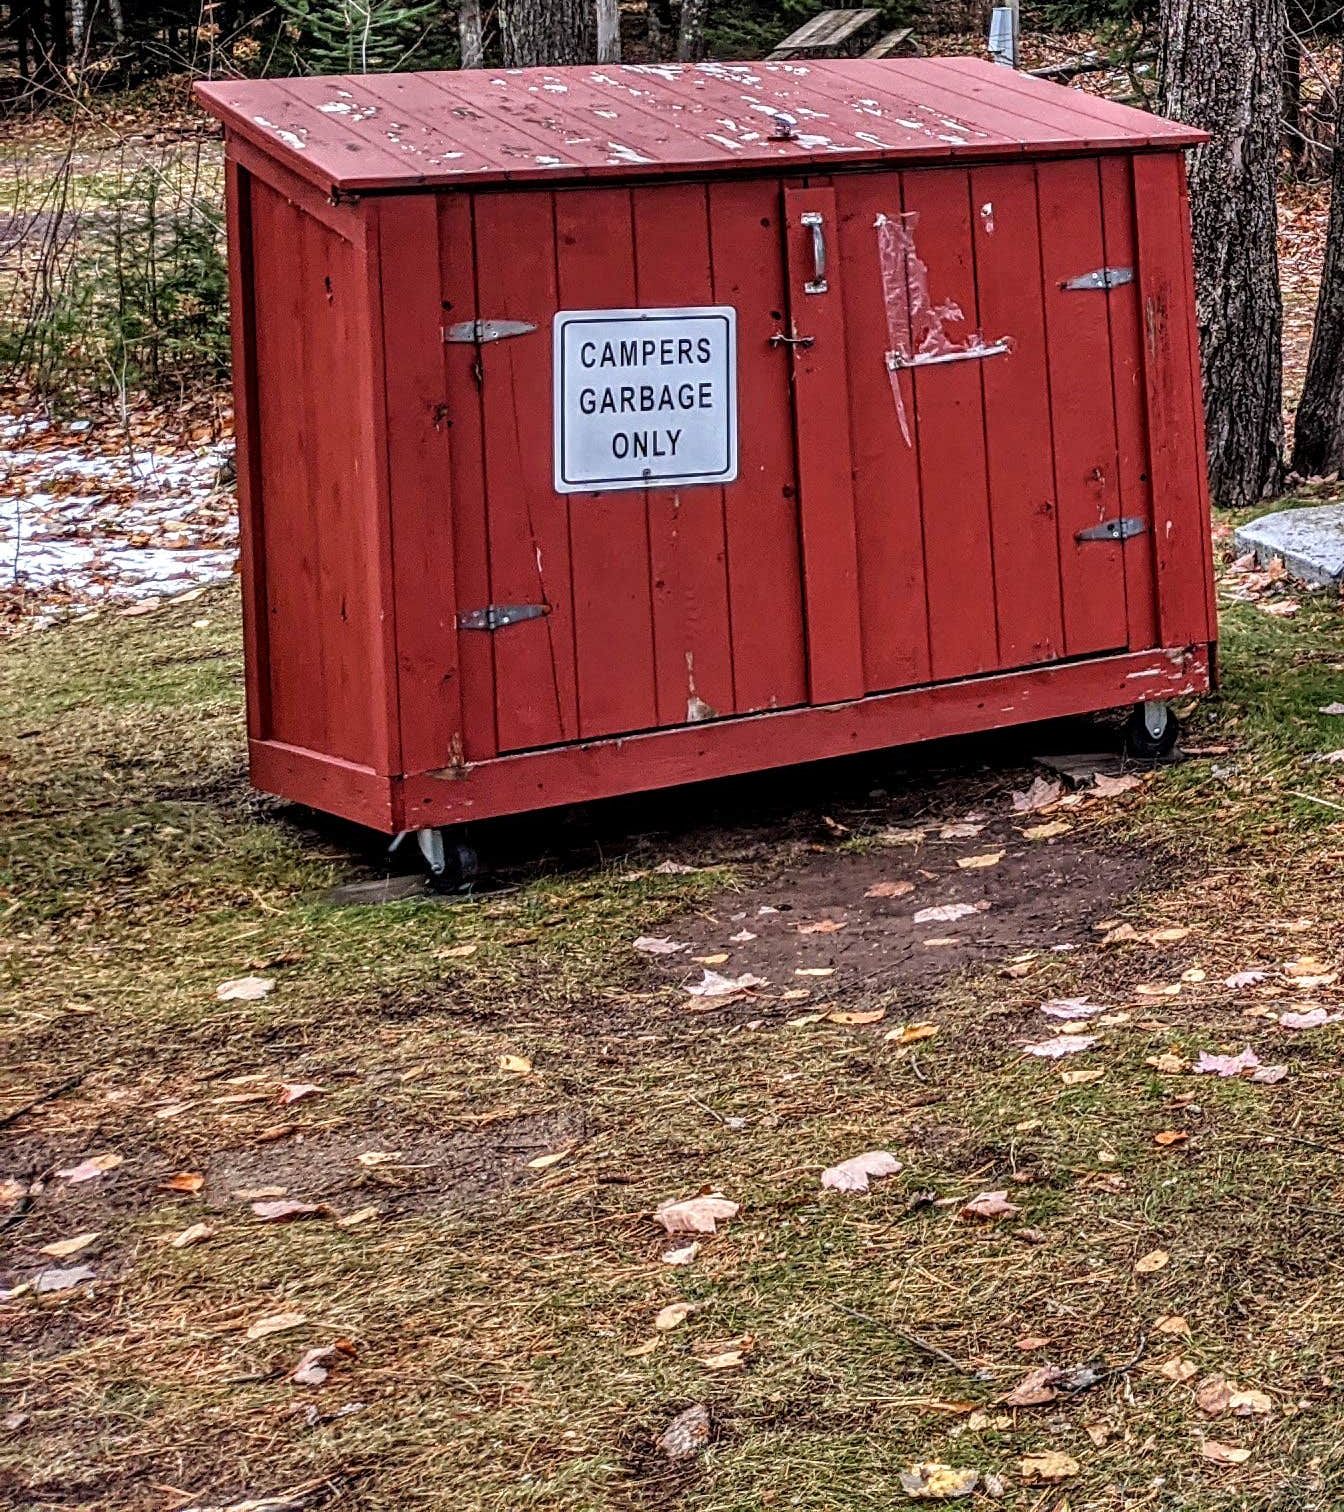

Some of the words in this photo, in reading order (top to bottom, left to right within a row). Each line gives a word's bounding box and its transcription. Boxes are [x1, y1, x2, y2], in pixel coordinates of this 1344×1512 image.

[580, 337, 712, 368] CAMPERS
[579, 382, 713, 415] GARBAGE
[611, 429, 683, 459] ONLY
